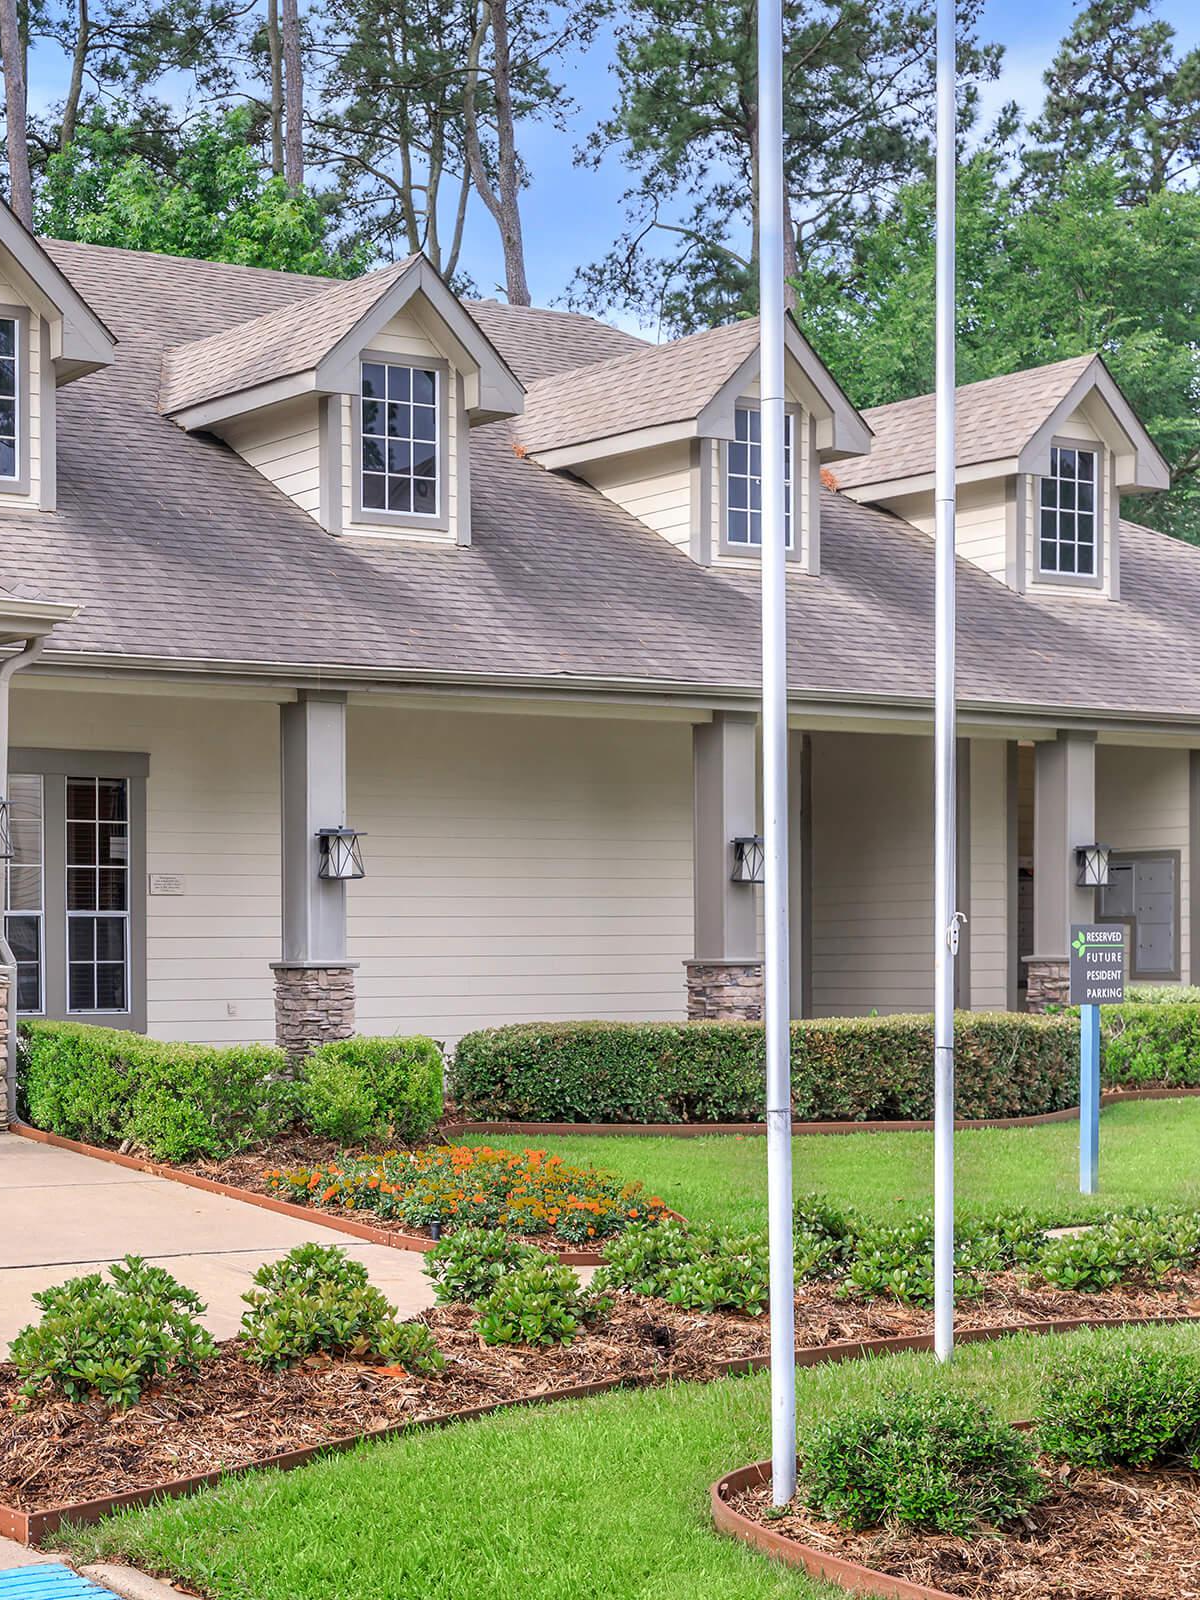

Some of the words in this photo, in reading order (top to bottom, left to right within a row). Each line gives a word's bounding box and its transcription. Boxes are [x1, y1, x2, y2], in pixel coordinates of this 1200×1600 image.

[1086, 931, 1122, 942] RESERVED
[1086, 952, 1122, 963] FUTURE
[1086, 988, 1122, 999] PARKING
